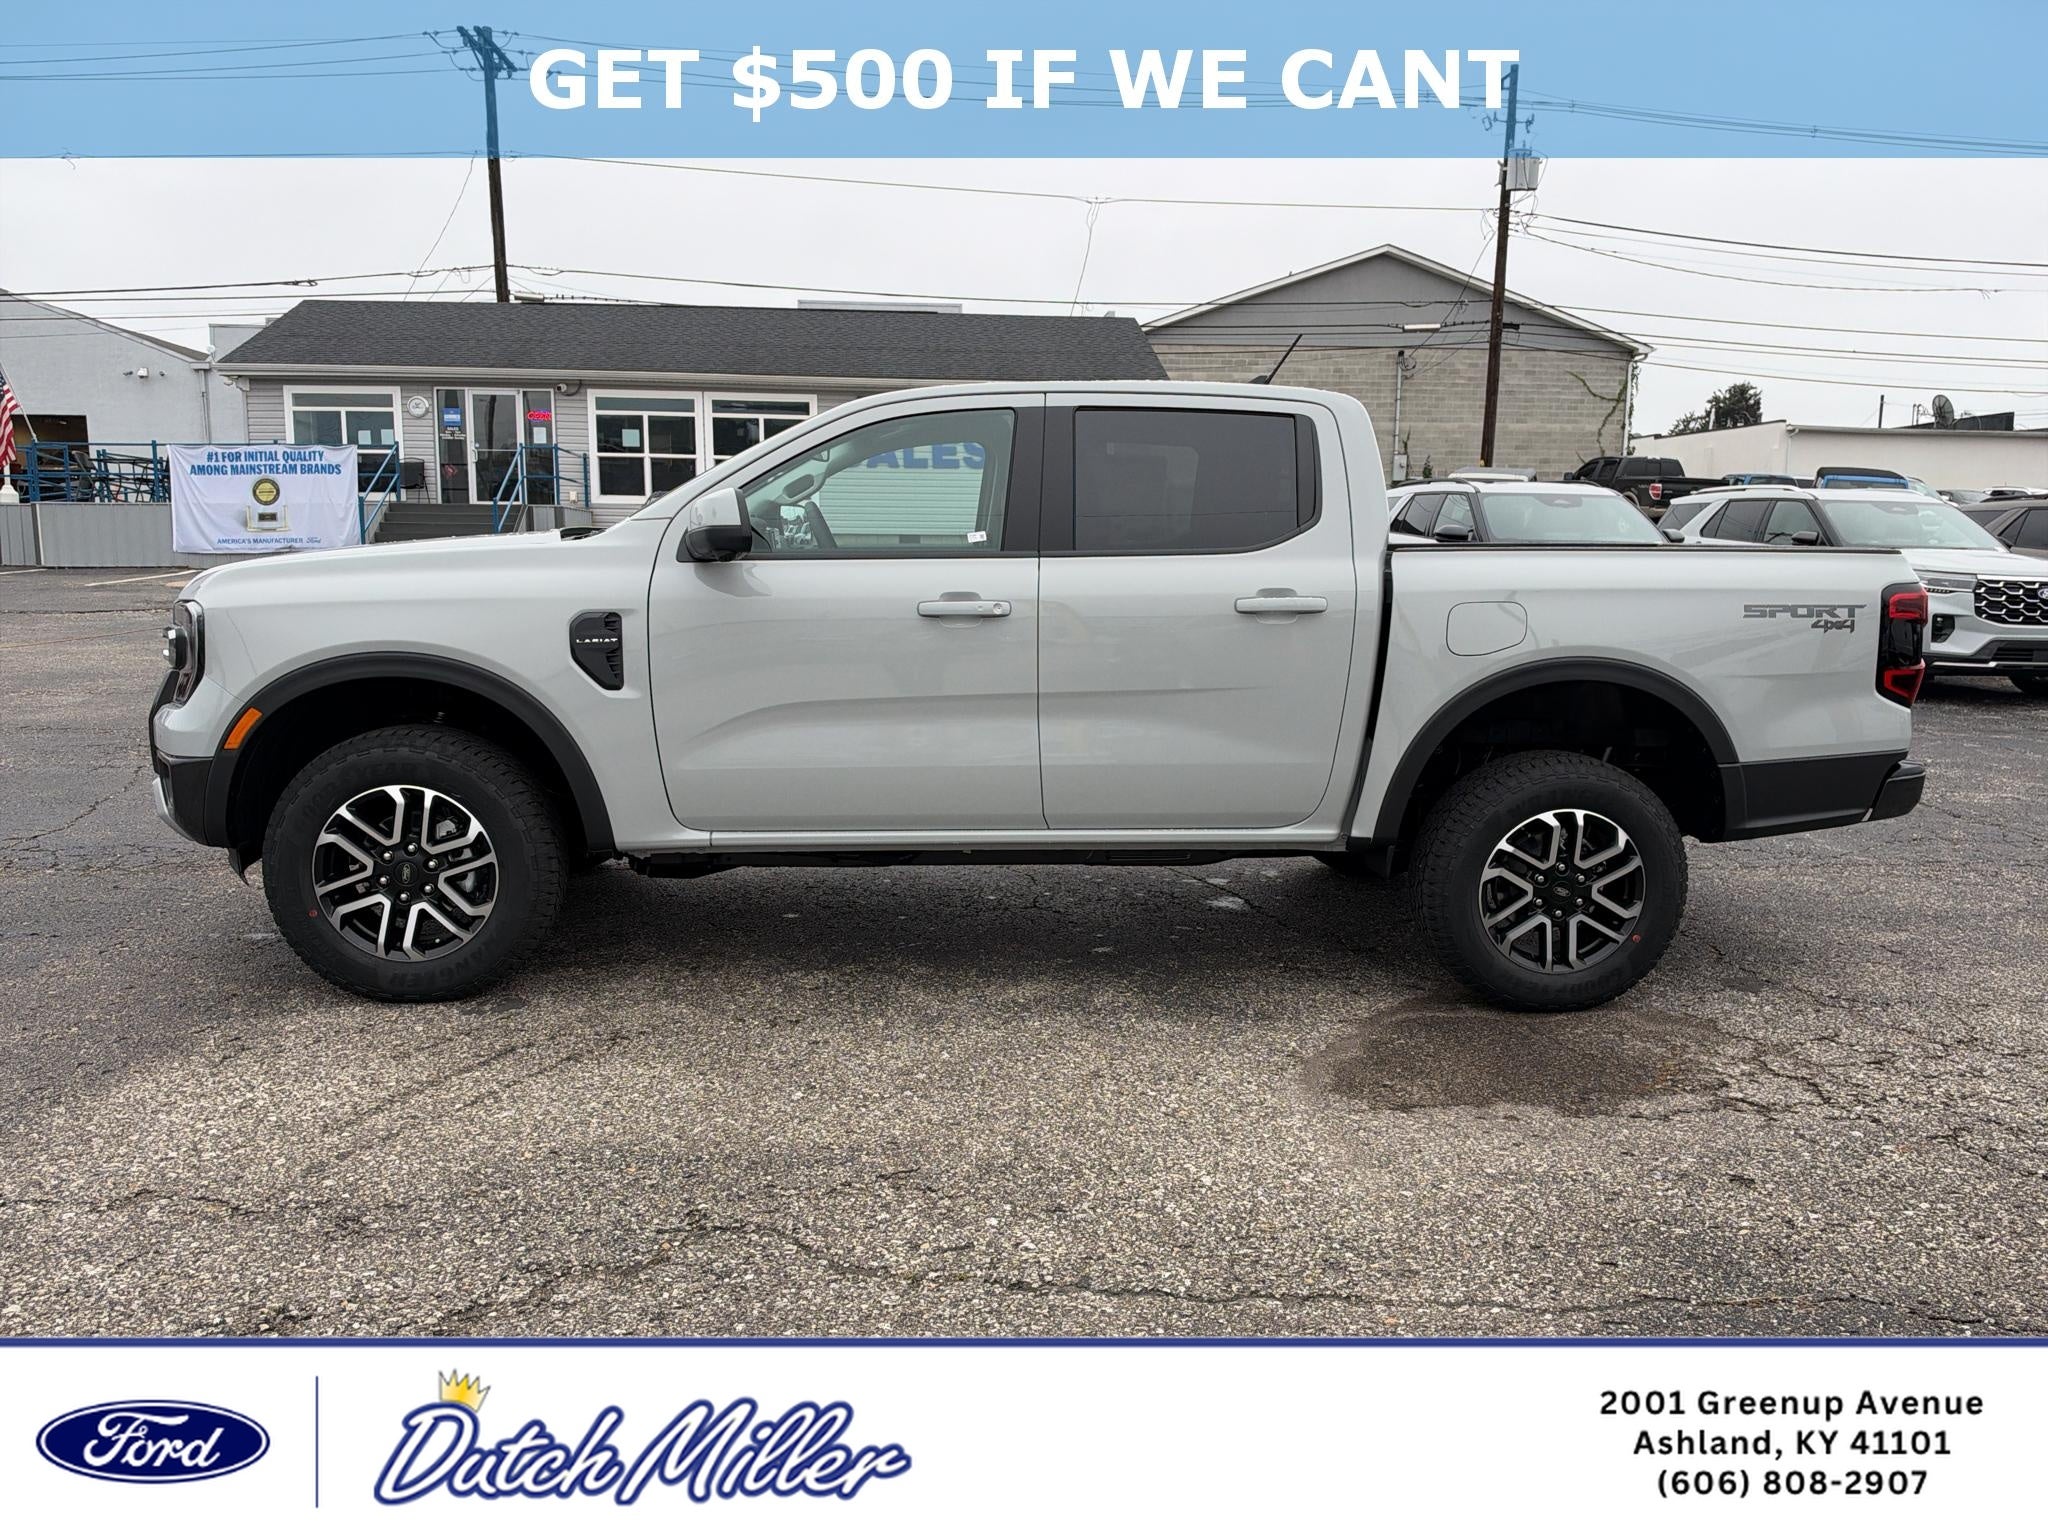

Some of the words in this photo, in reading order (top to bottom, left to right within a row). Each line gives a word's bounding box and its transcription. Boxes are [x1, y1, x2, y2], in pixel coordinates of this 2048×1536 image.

[206, 451, 219, 463] #1
[221, 451, 242, 463] FOR
[244, 450, 279, 463] INITIAL
[282, 450, 325, 463] QUALITY
[859, 442, 985, 469] ALES
[190, 463, 228, 475] AMONG
[230, 463, 298, 475] MAINSTREAM
[300, 463, 342, 475] BRANDS
[217, 537, 252, 545] AMERICA'S
[253, 537, 304, 545] MANUFACTURER
[1743, 604, 1867, 619] SPORT
[1811, 618, 1855, 634] 4x4
